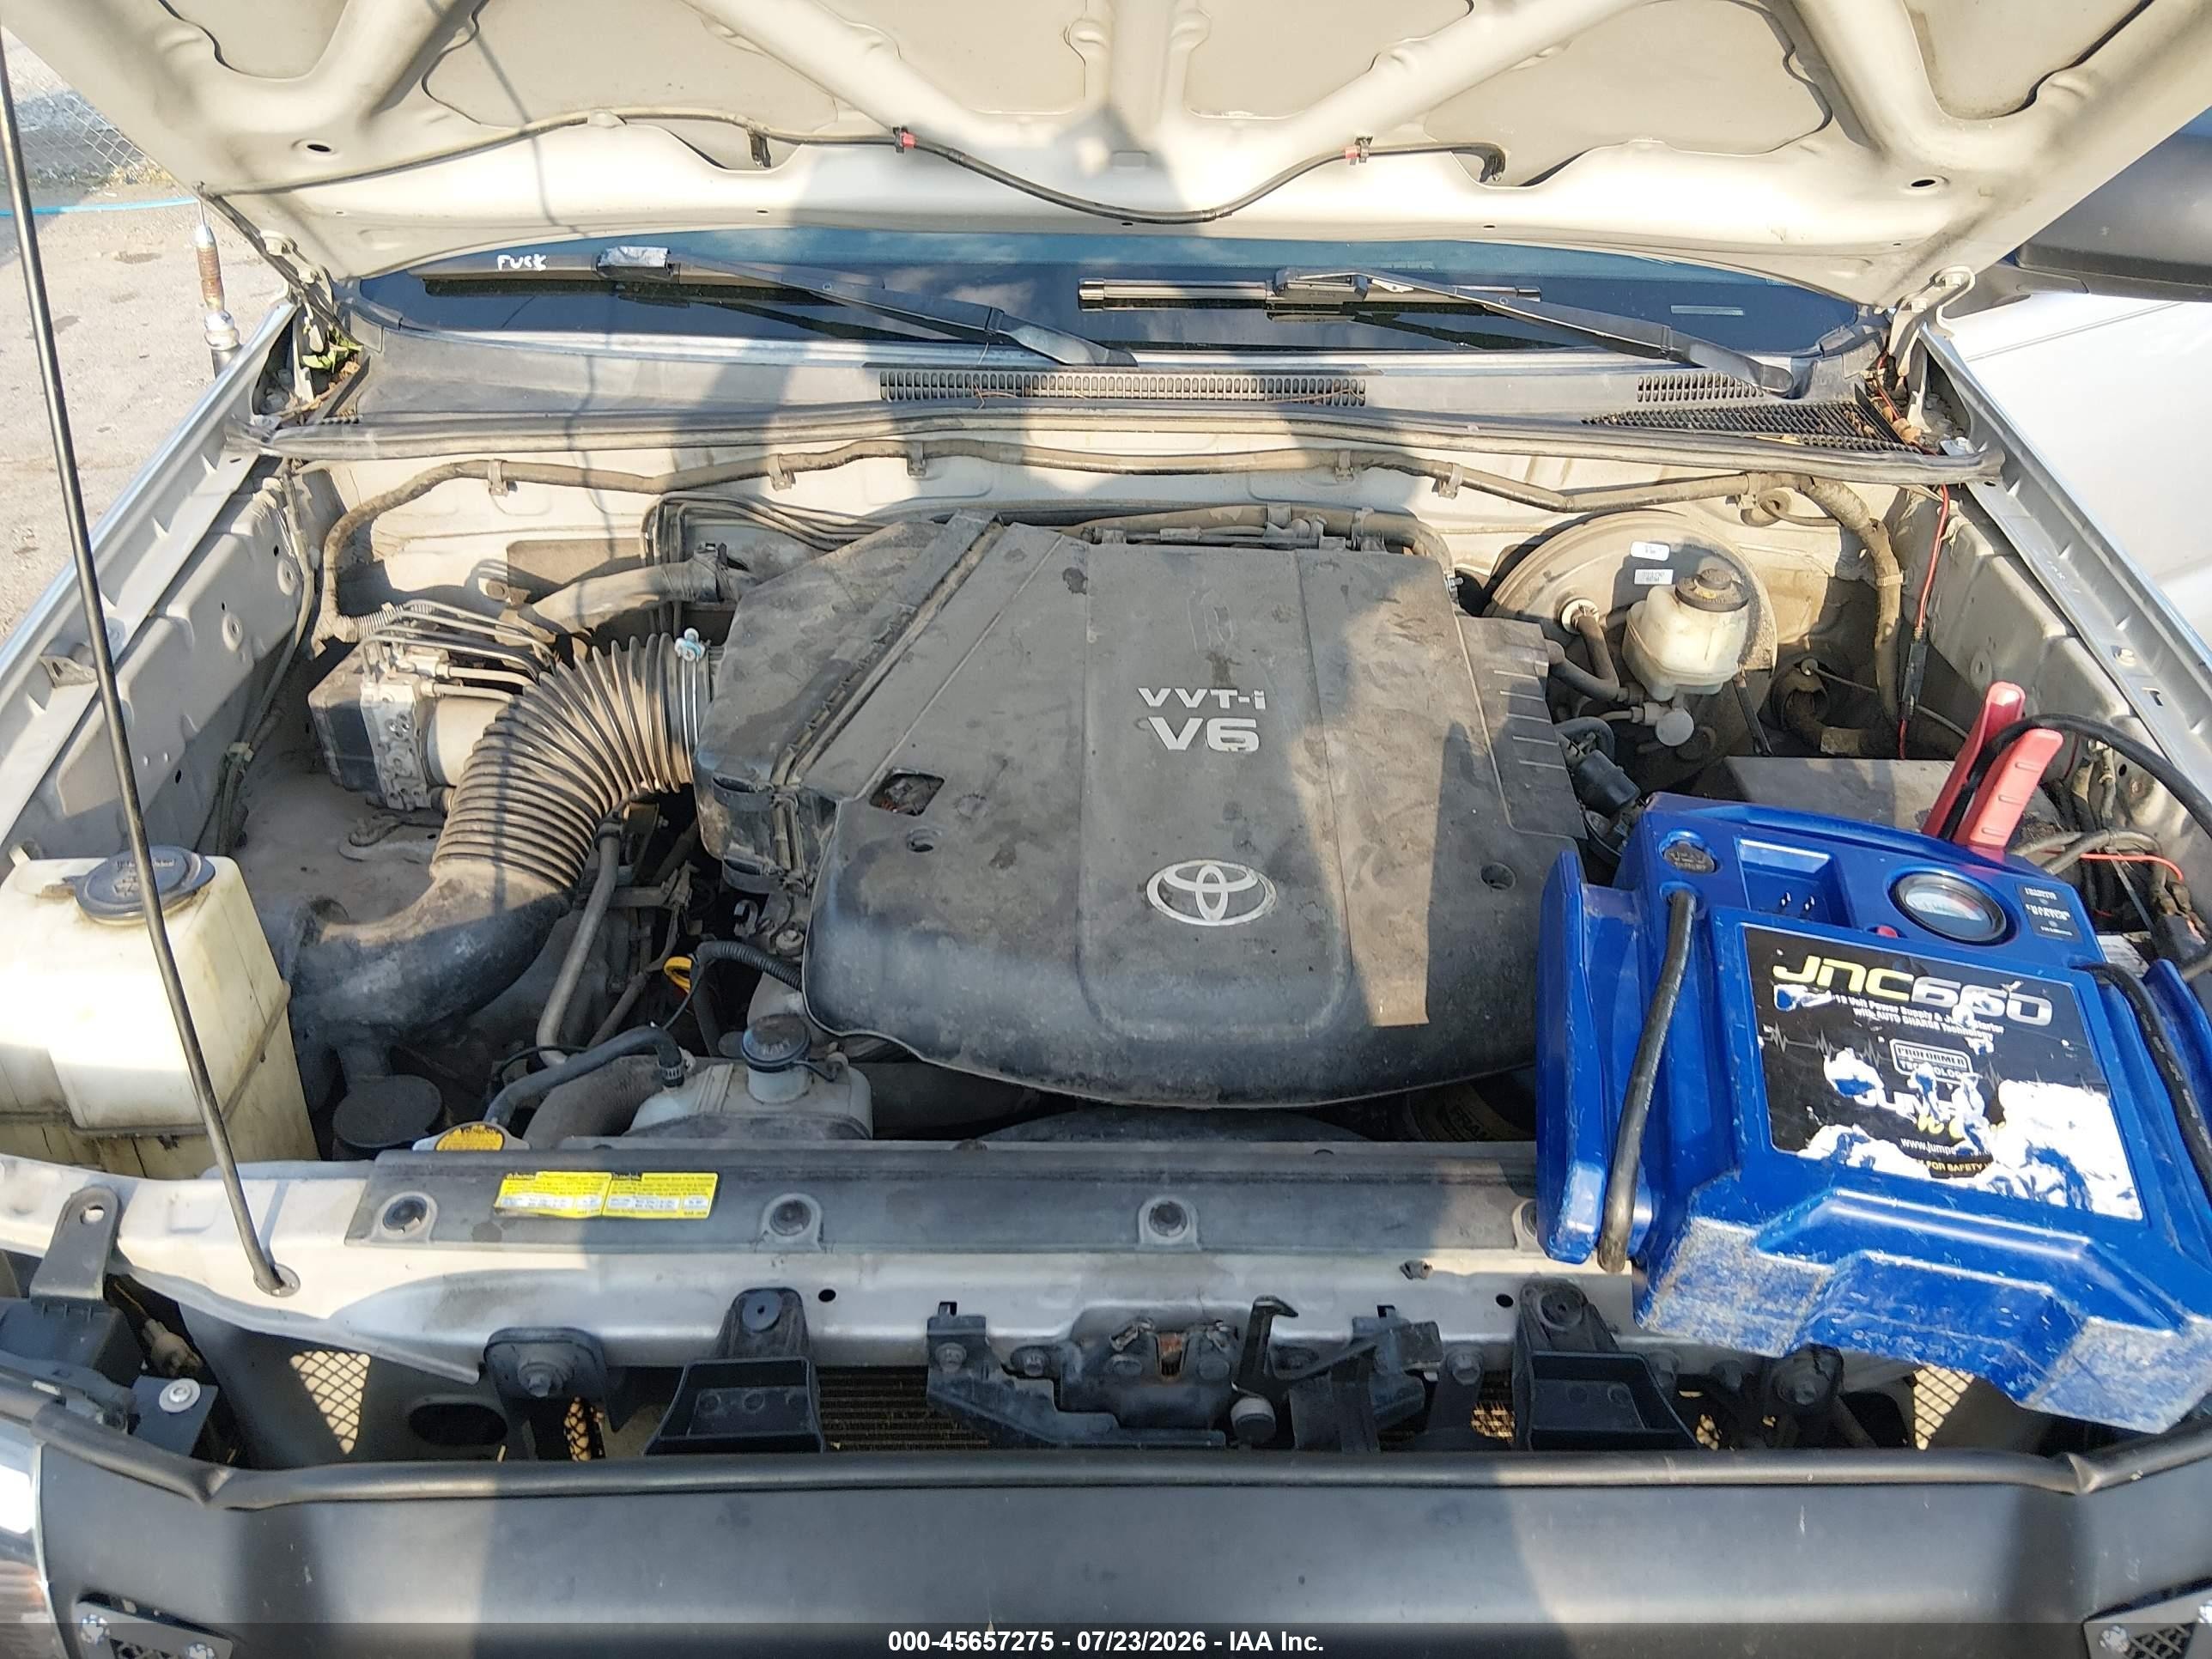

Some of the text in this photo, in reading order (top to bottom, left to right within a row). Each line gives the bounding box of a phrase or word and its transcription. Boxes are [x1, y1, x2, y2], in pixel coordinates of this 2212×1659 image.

[1147, 716, 1260, 752] V6
[1848, 996, 1869, 1008] Volt
[1869, 1000, 1899, 1014] Power
[1900, 1006, 1933, 1021] Supply
[1875, 1012, 1901, 1024] AUTO
[1898, 1047, 1965, 1066] PROFORMER
[1900, 1060, 1964, 1079] TECOLOG
[1947, 1161, 1983, 1172] SAFETY
